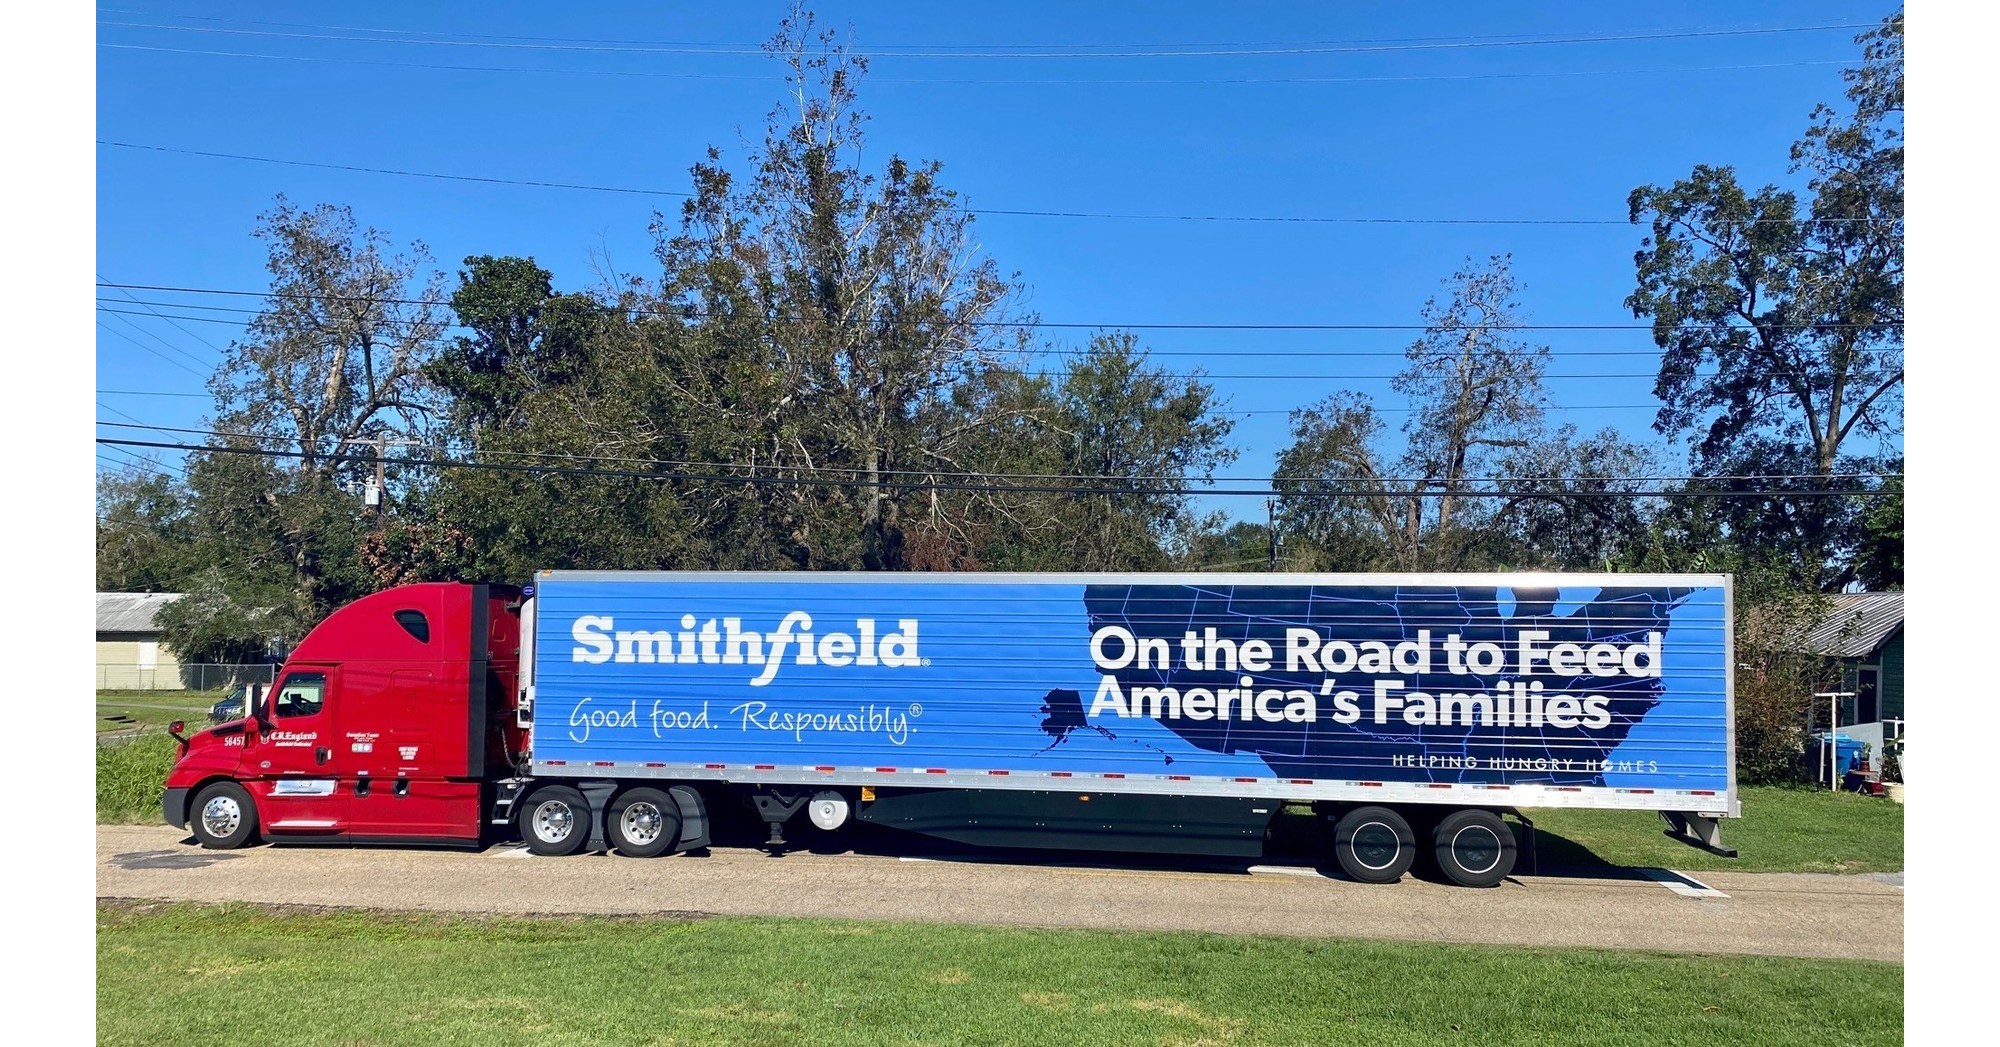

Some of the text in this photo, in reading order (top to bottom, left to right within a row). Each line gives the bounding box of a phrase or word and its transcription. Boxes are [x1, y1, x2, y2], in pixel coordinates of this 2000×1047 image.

[1090, 626, 1663, 678] On the Road to Feed
[569, 697, 638, 743] Good
[649, 699, 718, 738] food.
[1088, 675, 1611, 729] America’s Families
[224, 736, 245, 747] 56457
[1393, 755, 1477, 769] HELPING
[1490, 757, 1573, 771] HUNGRY
